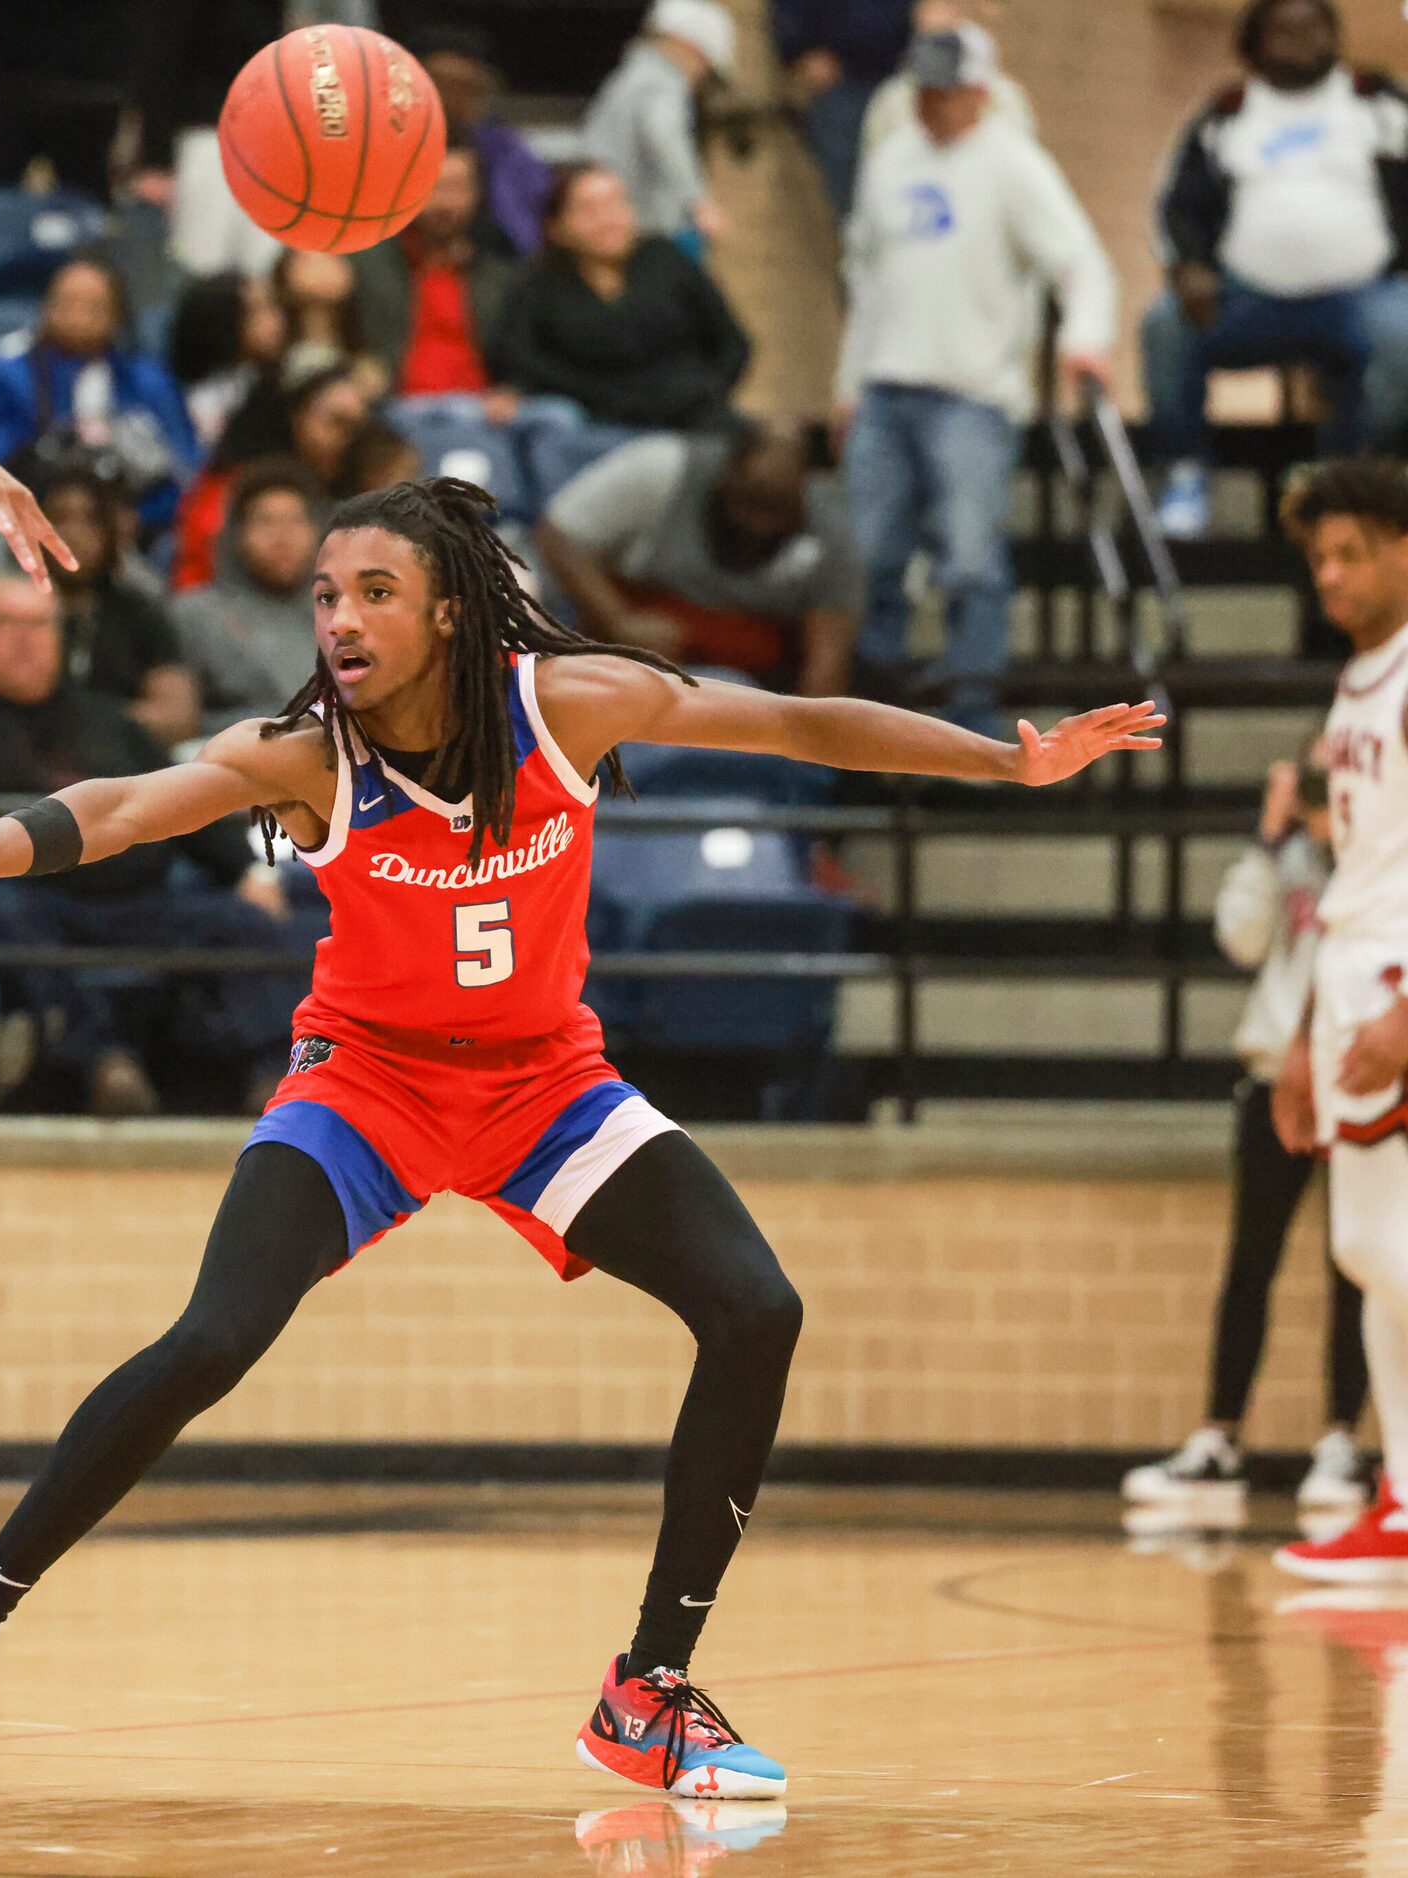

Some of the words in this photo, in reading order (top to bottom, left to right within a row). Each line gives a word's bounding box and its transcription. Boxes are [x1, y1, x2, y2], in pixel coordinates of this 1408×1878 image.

[369, 811, 575, 889] Duncanville
[453, 896, 516, 989] 5
[624, 1715, 646, 1741] 13
